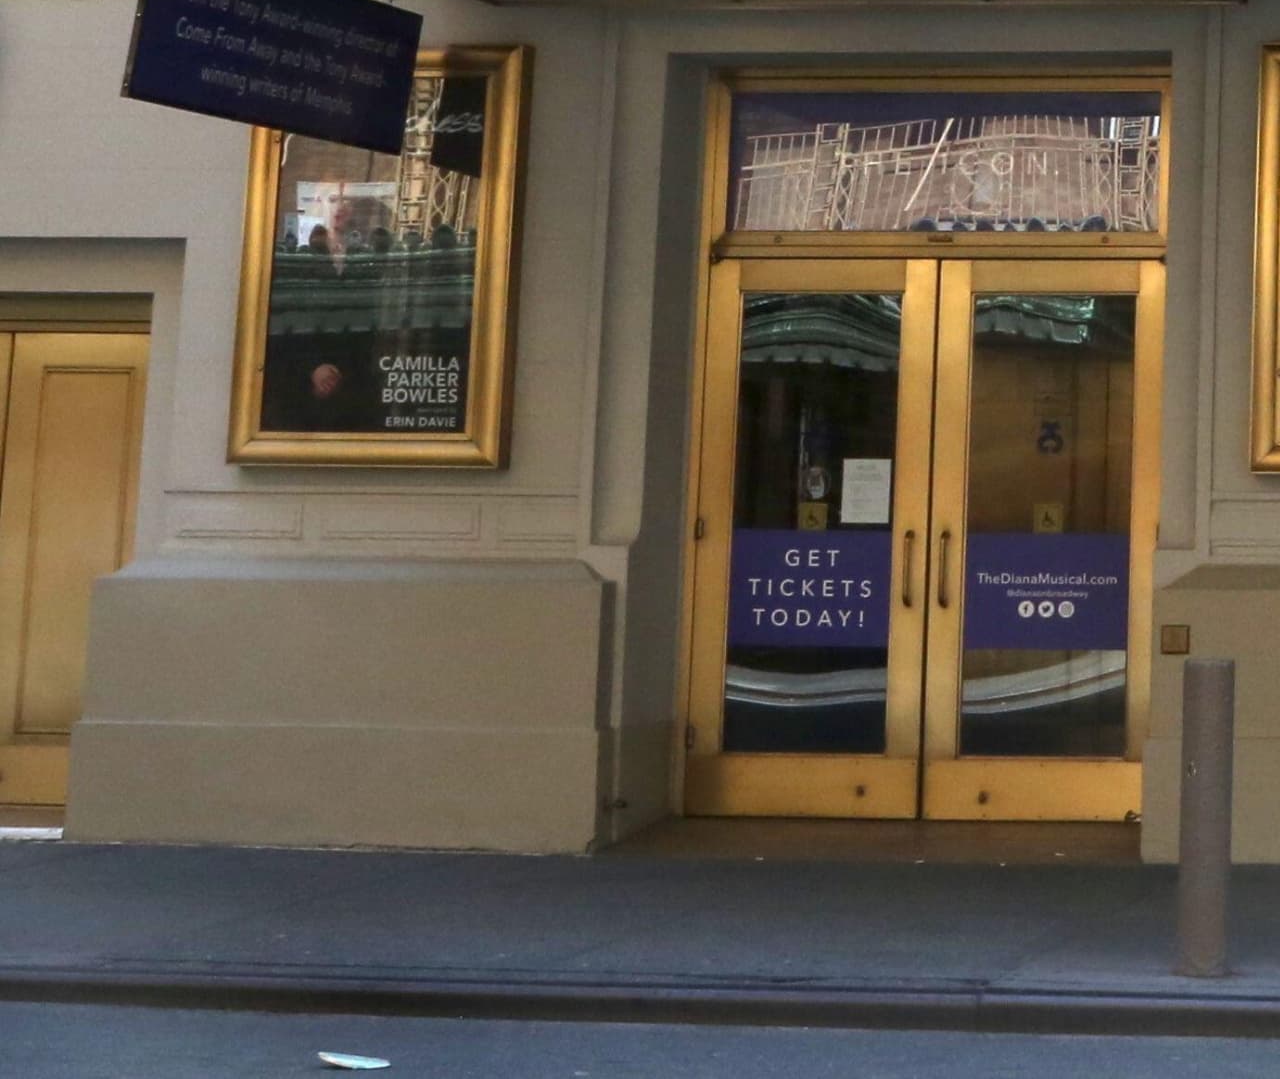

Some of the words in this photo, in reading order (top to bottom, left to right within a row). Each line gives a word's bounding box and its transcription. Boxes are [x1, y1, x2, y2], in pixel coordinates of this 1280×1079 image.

[176, 16, 212, 44] Come
[214, 26, 245, 50] From
[247, 36, 278, 66] Away
[281, 47, 301, 67] and
[303, 52, 321, 72] the
[325, 55, 347, 83] Tony
[201, 63, 247, 96] winning
[249, 75, 288, 100] writers
[290, 81, 304, 102] of
[379, 356, 459, 371] CAMILLA
[387, 372, 459, 387] PARKER
[382, 388, 458, 403] BOWLES
[385, 416, 415, 427] ERIN
[418, 416, 456, 427] DAVIE
[785, 549, 840, 567] GET
[977, 572, 1118, 585] TheDianaMusical.com
[748, 578, 872, 598] TICKETS
[752, 608, 864, 627] TODAY!
